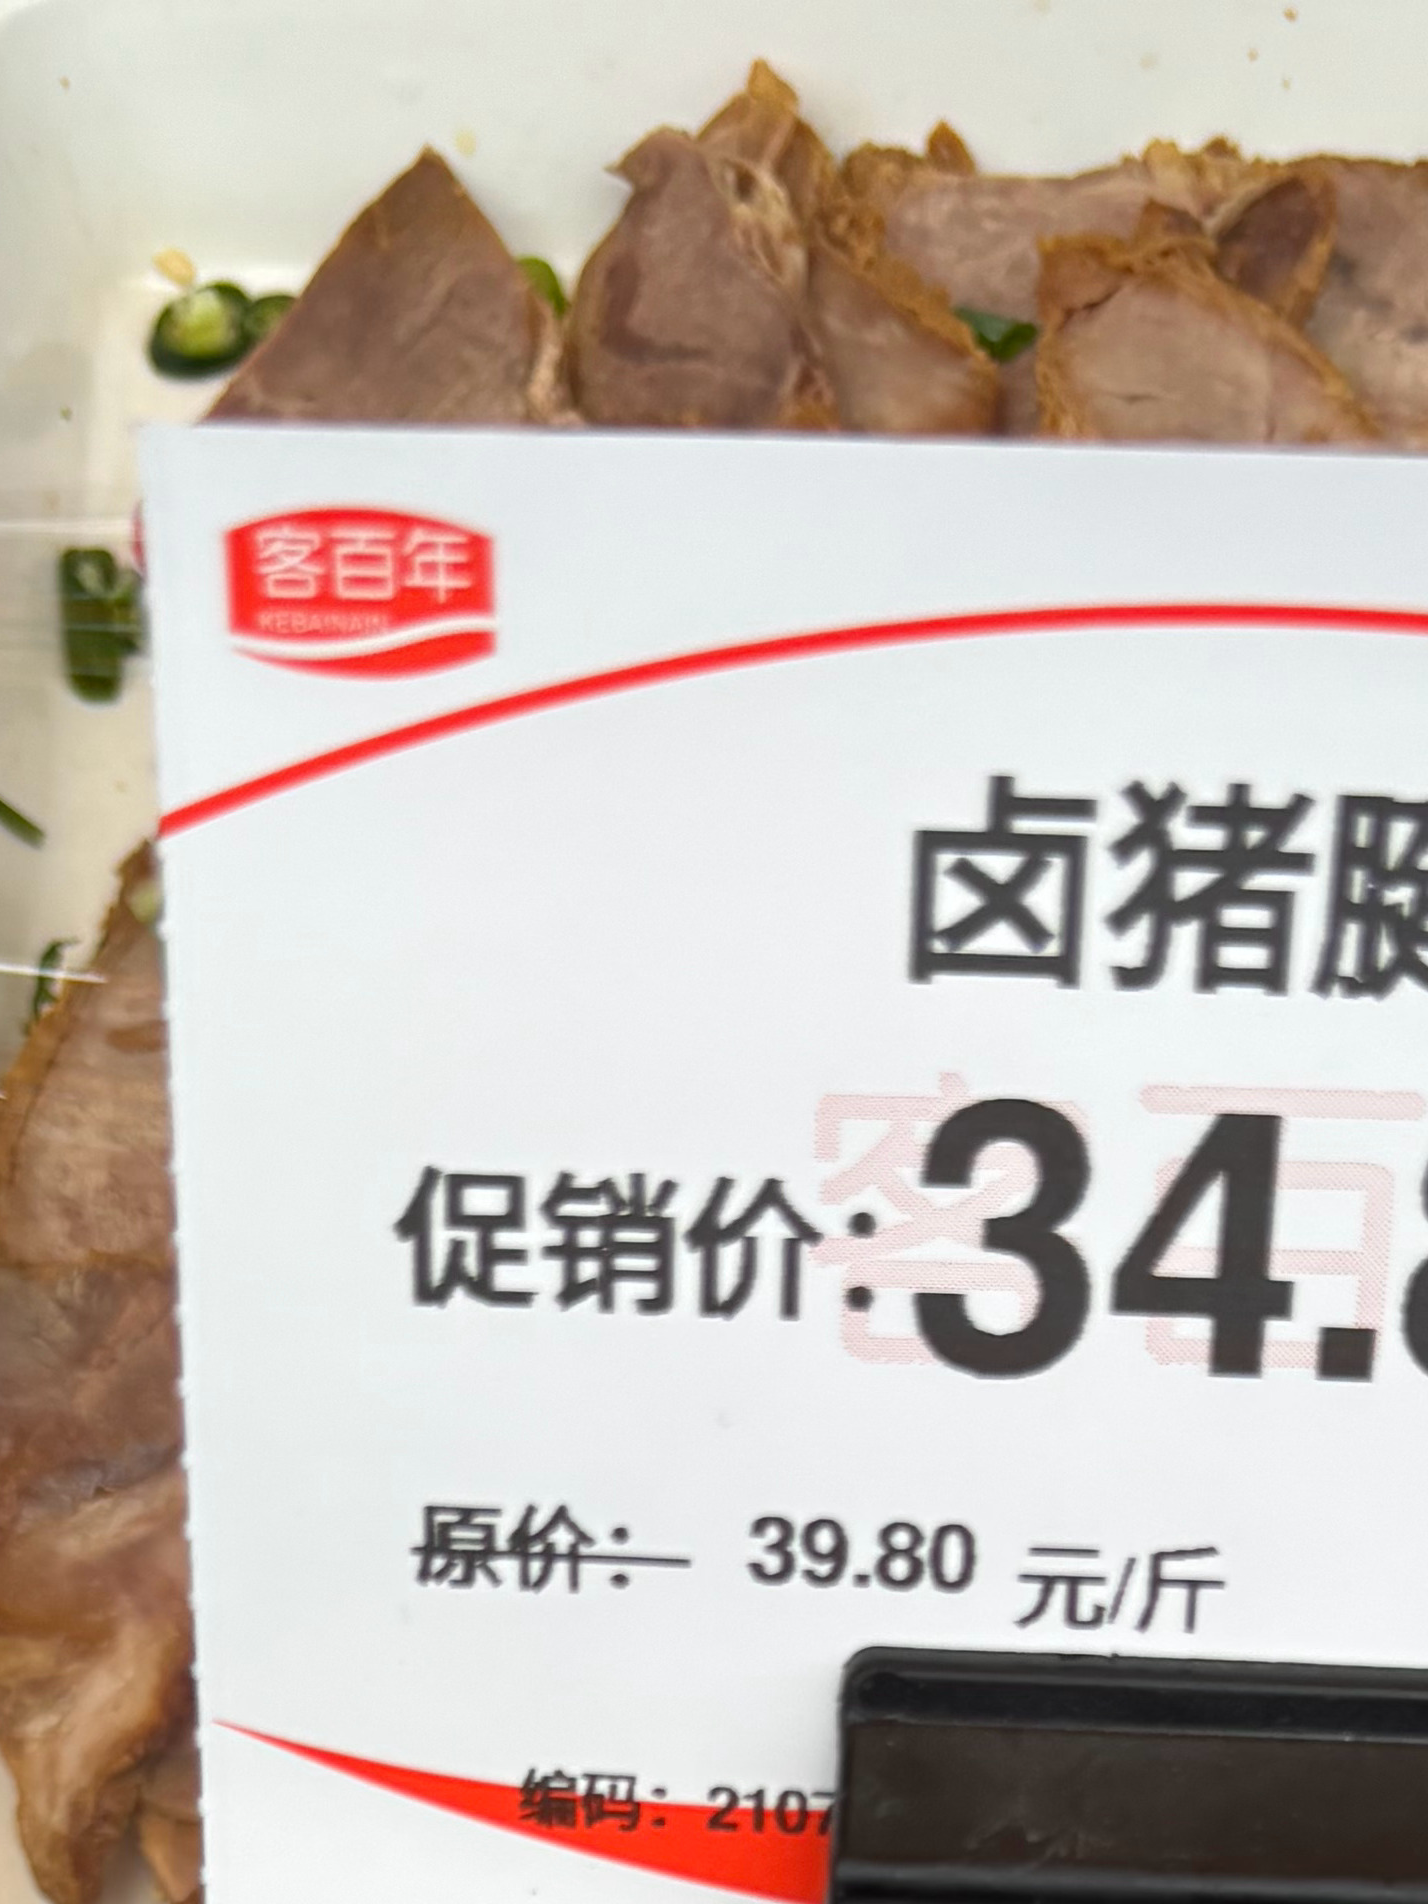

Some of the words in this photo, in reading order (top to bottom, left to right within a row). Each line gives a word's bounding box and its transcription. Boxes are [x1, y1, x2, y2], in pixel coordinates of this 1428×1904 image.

[254, 524, 472, 604] 客百年
[748, 1515, 977, 1593] 39.80
[1015, 1545, 1226, 1632] 元/斤
